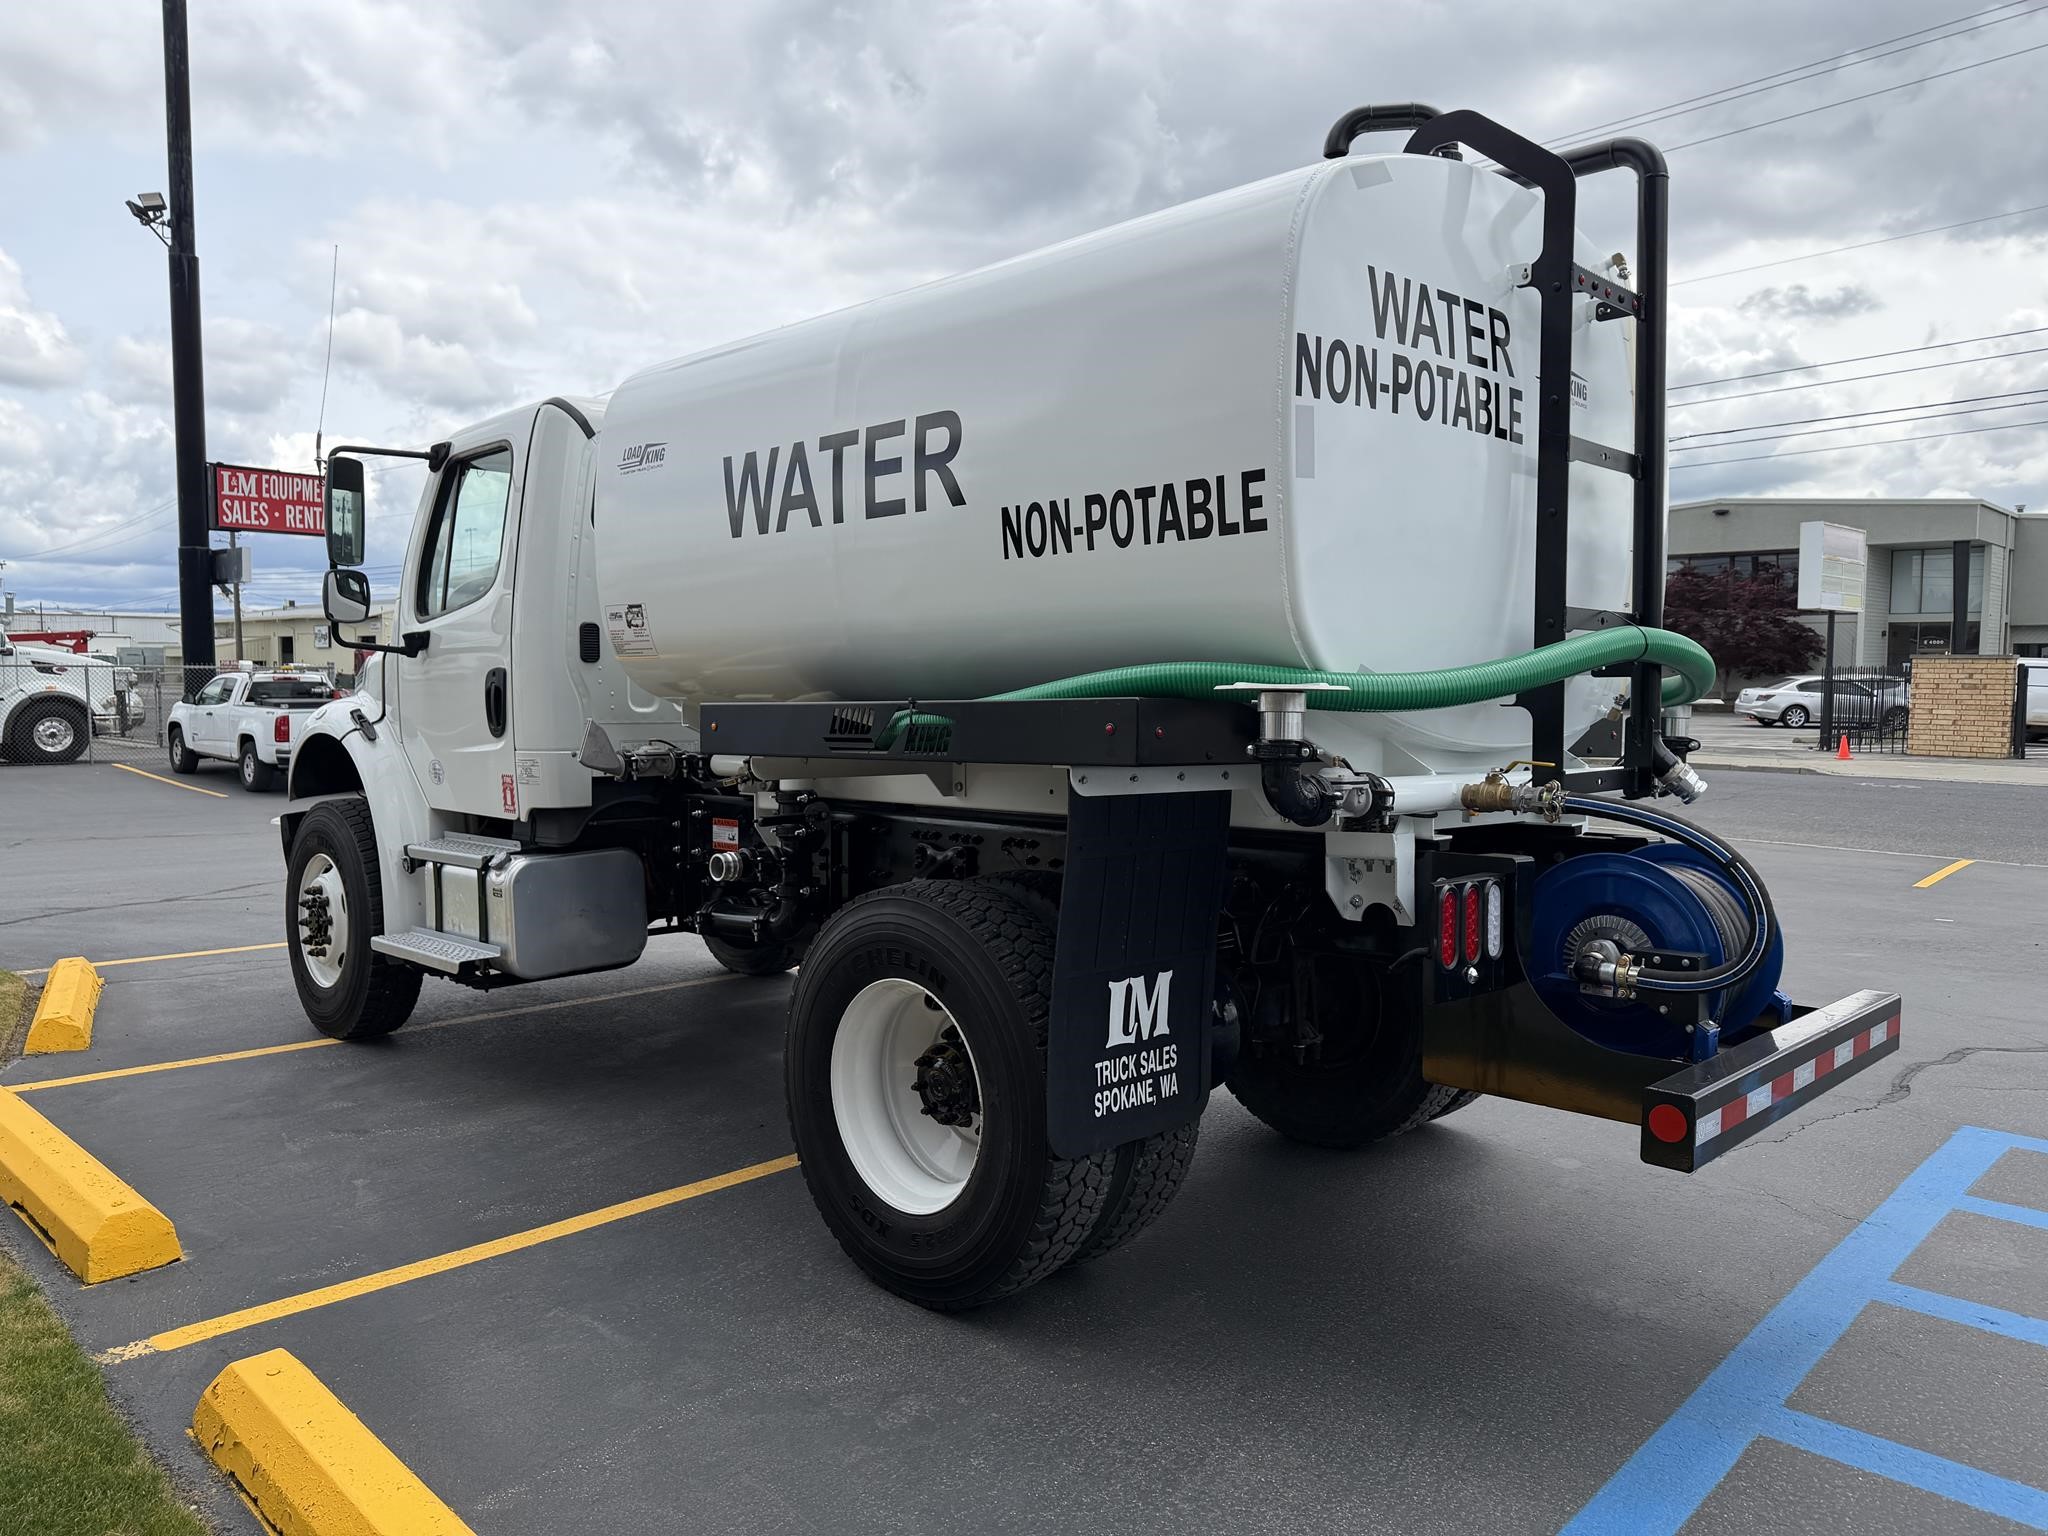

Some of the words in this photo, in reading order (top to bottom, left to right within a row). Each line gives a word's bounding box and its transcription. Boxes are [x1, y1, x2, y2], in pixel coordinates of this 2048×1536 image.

[1366, 264, 1515, 378] WATER
[1295, 332, 1523, 445] NON-POTABLE
[622, 445, 642, 462] LOAD
[645, 447, 666, 464] KING
[722, 409, 968, 539] WATER
[220, 470, 259, 498] L&M
[261, 474, 325, 503] EQUIPME
[222, 499, 269, 527] SALES
[1000, 468, 1269, 560] NON-POTABLE
[829, 706, 876, 735] LOAD
[903, 723, 953, 755] KING
[1094, 1053, 1138, 1087] TRUCK
[1140, 1044, 1178, 1075] SALES
[1094, 1081, 1157, 1118] SPOKANE,
[1160, 1073, 1179, 1098] WA
